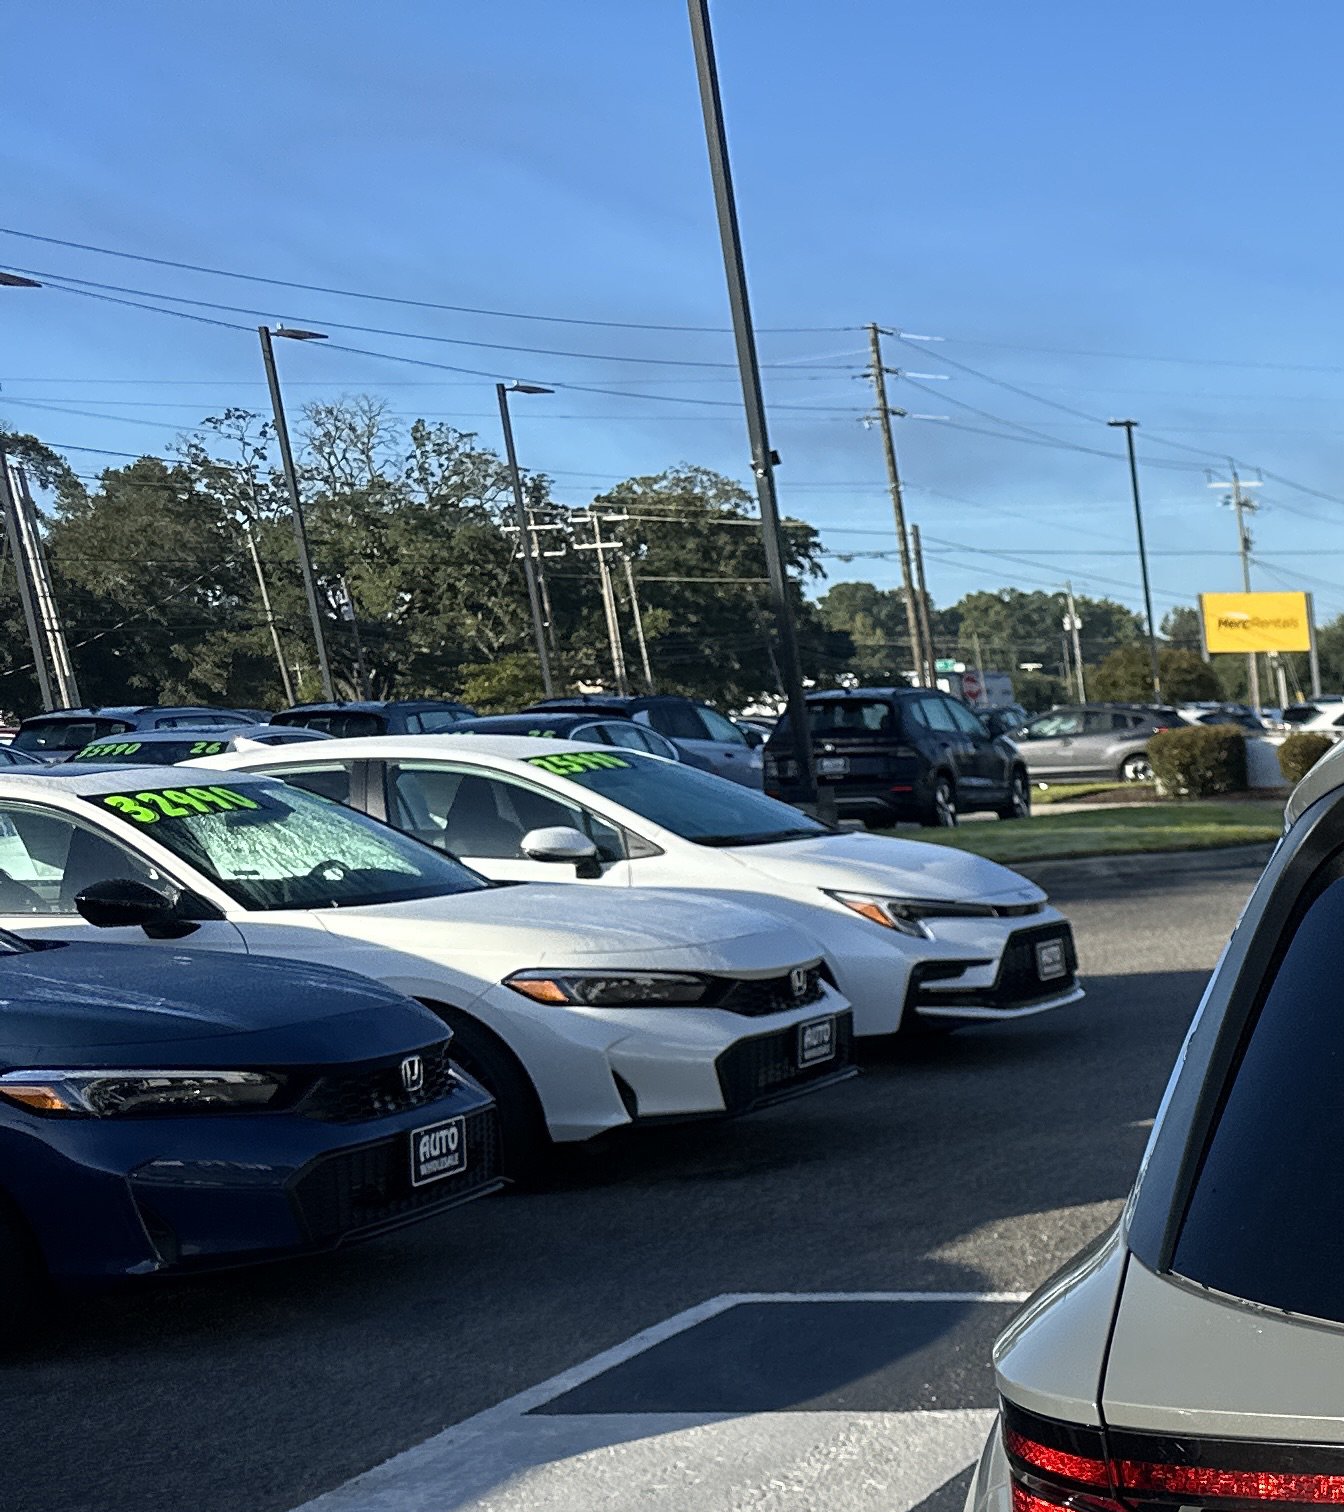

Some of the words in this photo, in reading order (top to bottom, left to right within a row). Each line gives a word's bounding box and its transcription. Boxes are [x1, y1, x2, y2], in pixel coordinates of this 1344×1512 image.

[189, 742, 222, 754] 26
[103, 786, 258, 824] 32990
[419, 1126, 459, 1162] AUTO
